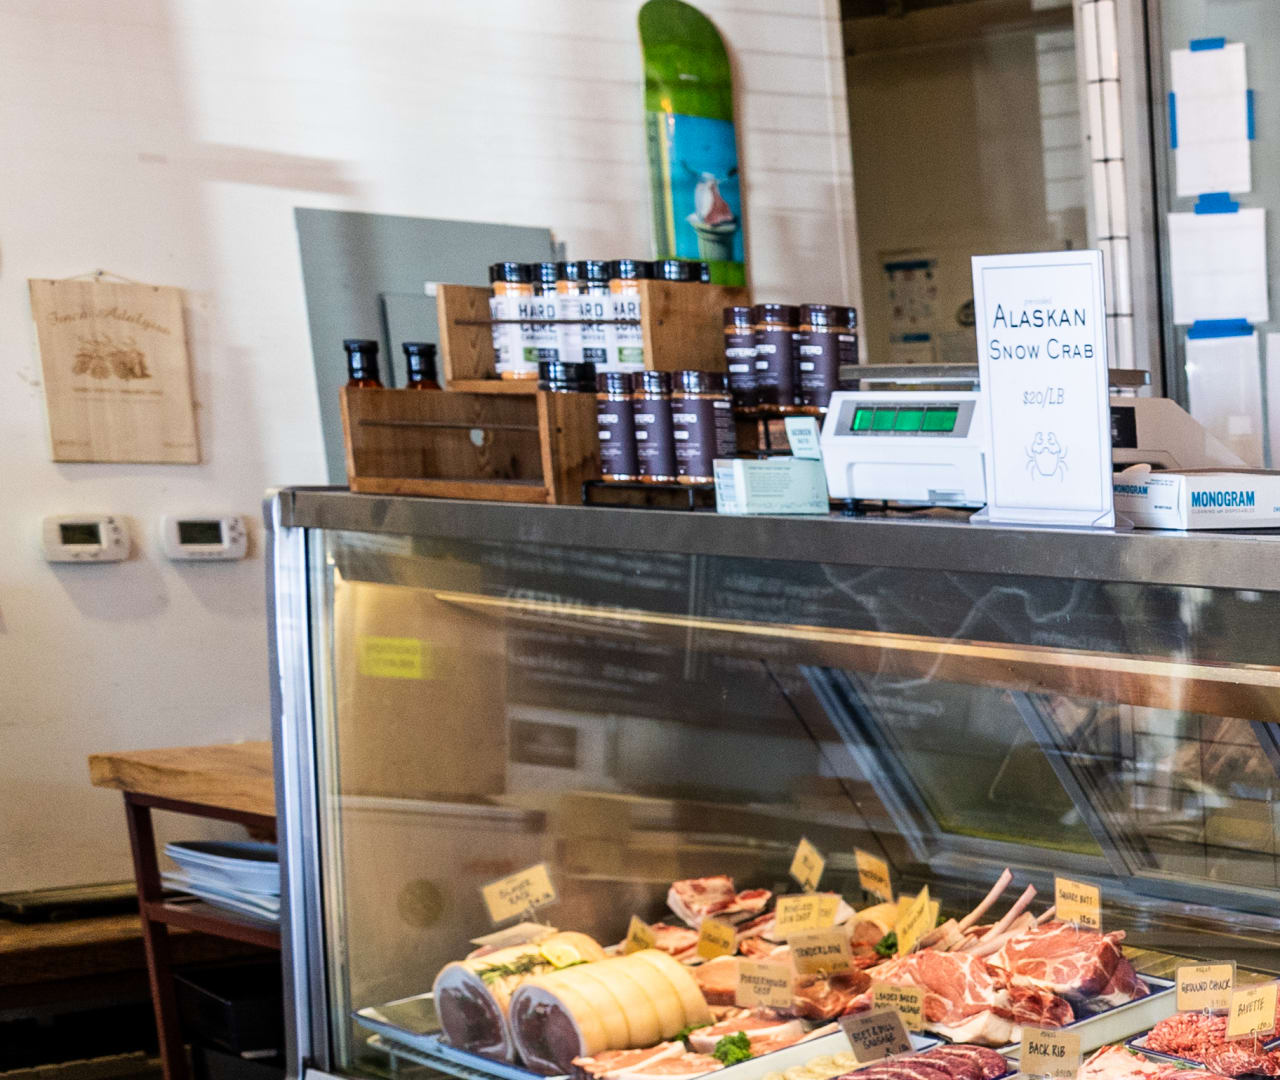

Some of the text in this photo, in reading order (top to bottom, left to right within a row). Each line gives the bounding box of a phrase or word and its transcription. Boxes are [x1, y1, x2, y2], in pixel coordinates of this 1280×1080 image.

[518, 303, 556, 318] HARD
[993, 304, 1086, 329] ALASKAN
[990, 338, 1094, 360] SNOW CRAB
[1023, 387, 1065, 408] $20/LB
[1192, 491, 1255, 507] MONOGRAM
[1181, 978, 1231, 994] GROUND CHUCK
[1028, 1041, 1066, 1058] BACK RIB
